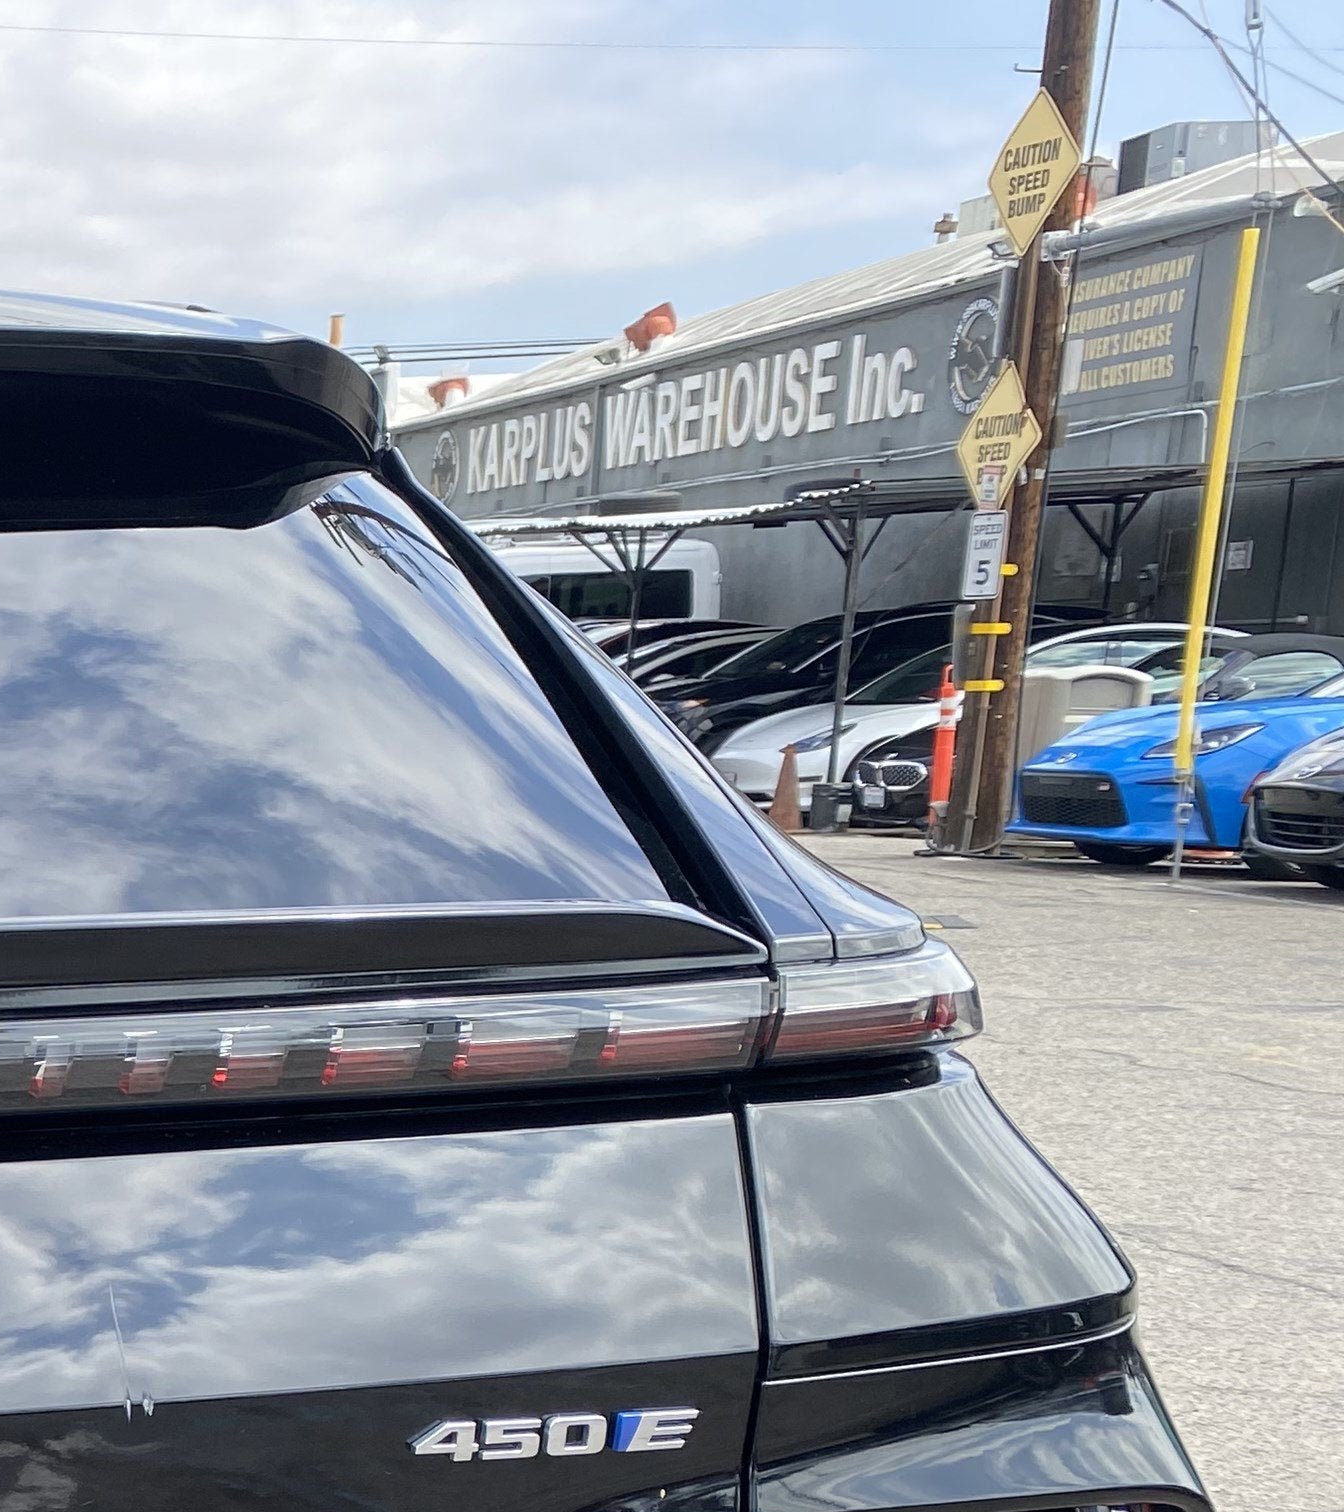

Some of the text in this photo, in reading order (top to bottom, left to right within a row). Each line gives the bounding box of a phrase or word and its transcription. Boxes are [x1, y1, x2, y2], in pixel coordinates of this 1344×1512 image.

[1004, 136, 1062, 172] CAUTION
[1008, 169, 1050, 196] SPEED
[1007, 193, 1046, 219] BUMP
[1132, 255, 1195, 290] COMPANY
[1121, 301, 1130, 323] A
[1132, 293, 1167, 321] COPY
[1168, 288, 1185, 314] OF
[1122, 322, 1174, 354] LICENSE
[1100, 354, 1175, 388] CUSTOMERS
[467, 402, 594, 494] KARPLUS
[605, 340, 843, 470] WAREHOUSE
[847, 334, 926, 426] Inc.
[975, 413, 1022, 439] CAUTION
[977, 442, 1011, 463] SPEED
[976, 464, 1008, 485] BP
[973, 523, 1002, 536] SPEED
[973, 538, 999, 550] LIMIT
[973, 559, 992, 586] 5
